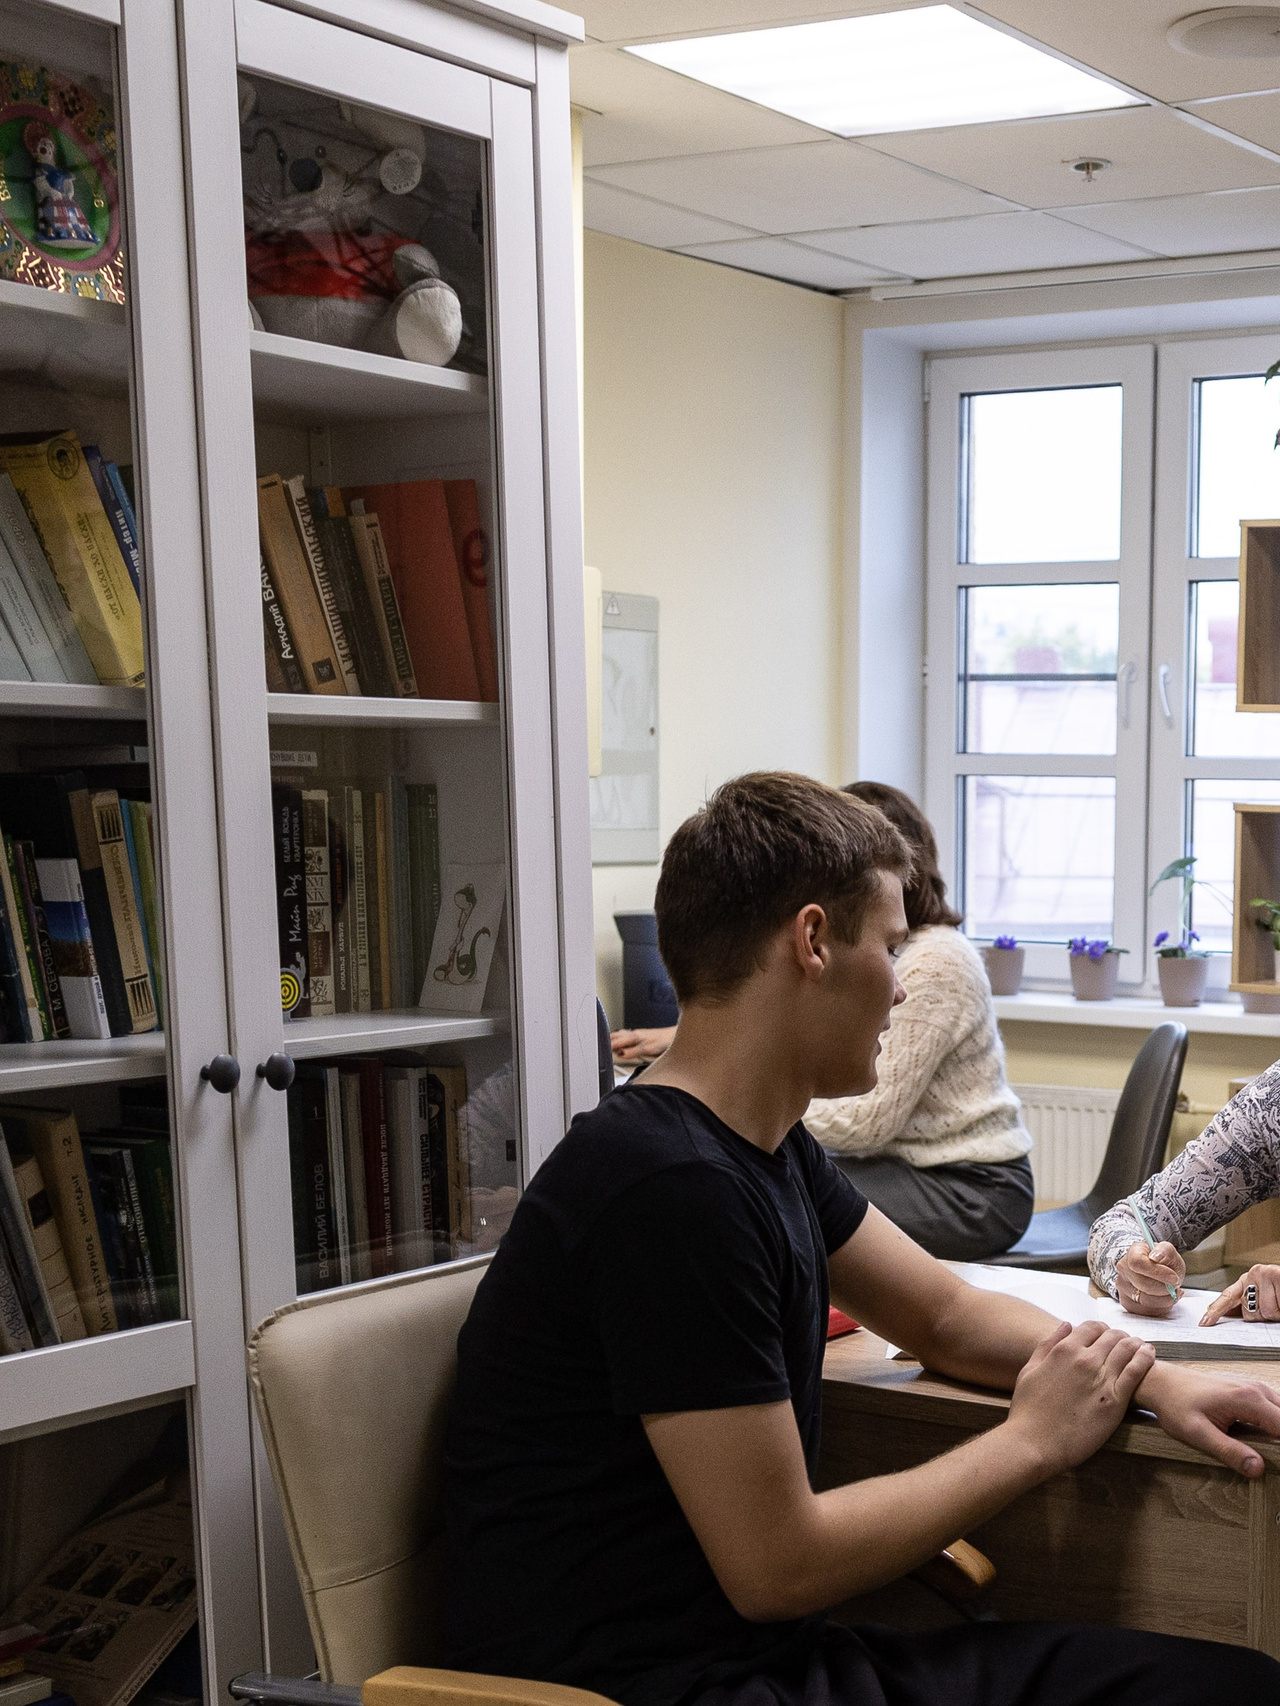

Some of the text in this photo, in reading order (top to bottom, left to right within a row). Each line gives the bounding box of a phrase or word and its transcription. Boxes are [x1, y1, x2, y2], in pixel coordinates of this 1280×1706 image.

[281, 806, 291, 863] БЕЛЫЙ ВОЖДЬ
[292, 810, 301, 863] КВАРТЕРОНКА
[282, 873, 303, 943] Майн Рид
[38, 939, 60, 993] СЕРОВА
[338, 955, 348, 991] РОНАЛЬД
[379, 1150, 390, 1193] ДВАДЦАТИ
[419, 1133, 432, 1230] СИЛЬНЕЕ СТРАСТИ
[312, 1163, 331, 1279] ВАСИЛИЙ БЕЛОВ
